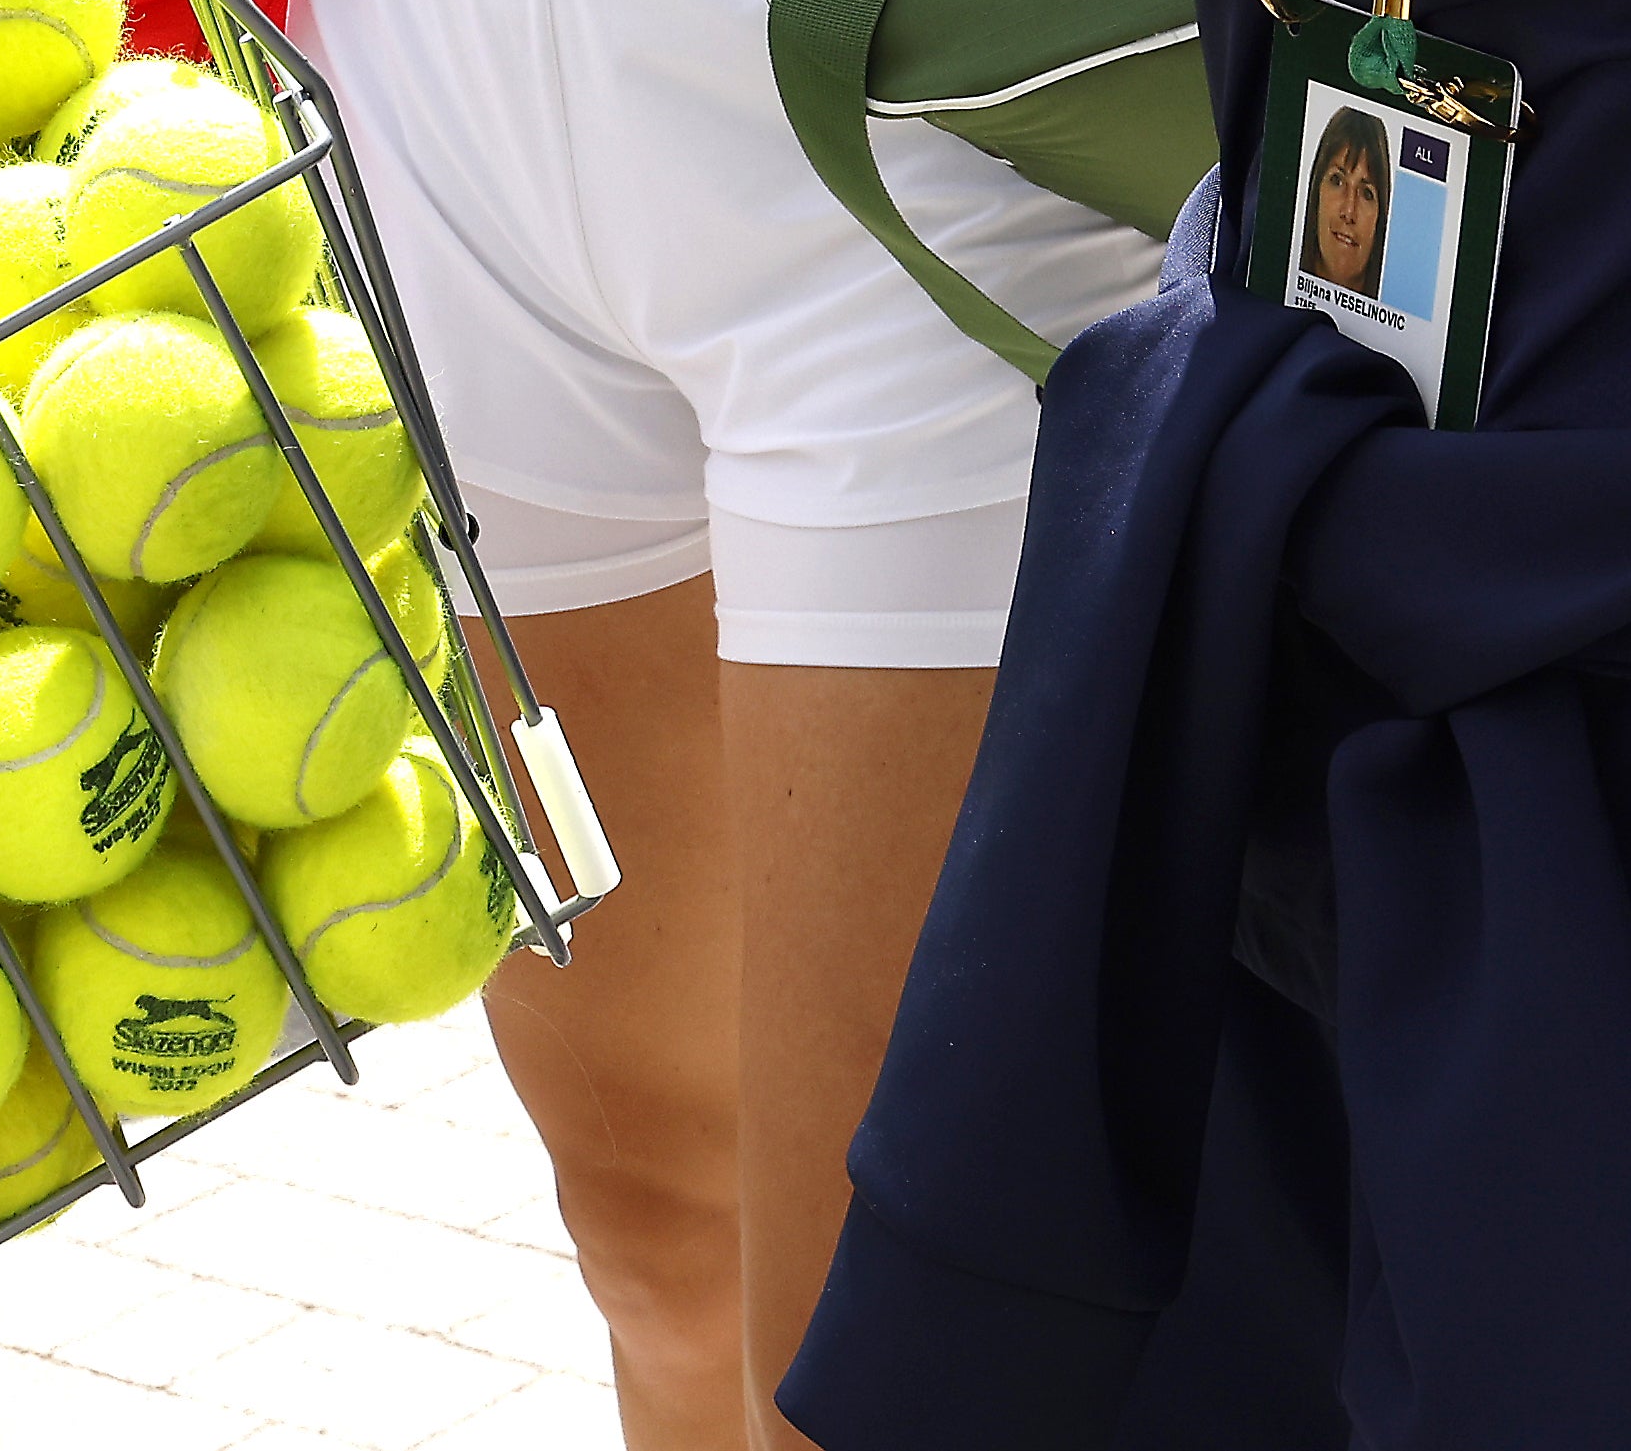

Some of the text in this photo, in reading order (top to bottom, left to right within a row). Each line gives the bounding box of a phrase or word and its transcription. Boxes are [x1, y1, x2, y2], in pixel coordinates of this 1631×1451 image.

[1414, 145, 1434, 165] ALL
[1296, 275, 1407, 332] Biljana VESELINOVIC
[111, 1057, 236, 1079] WIMBLEDON
[148, 1078, 198, 1091] 2022
